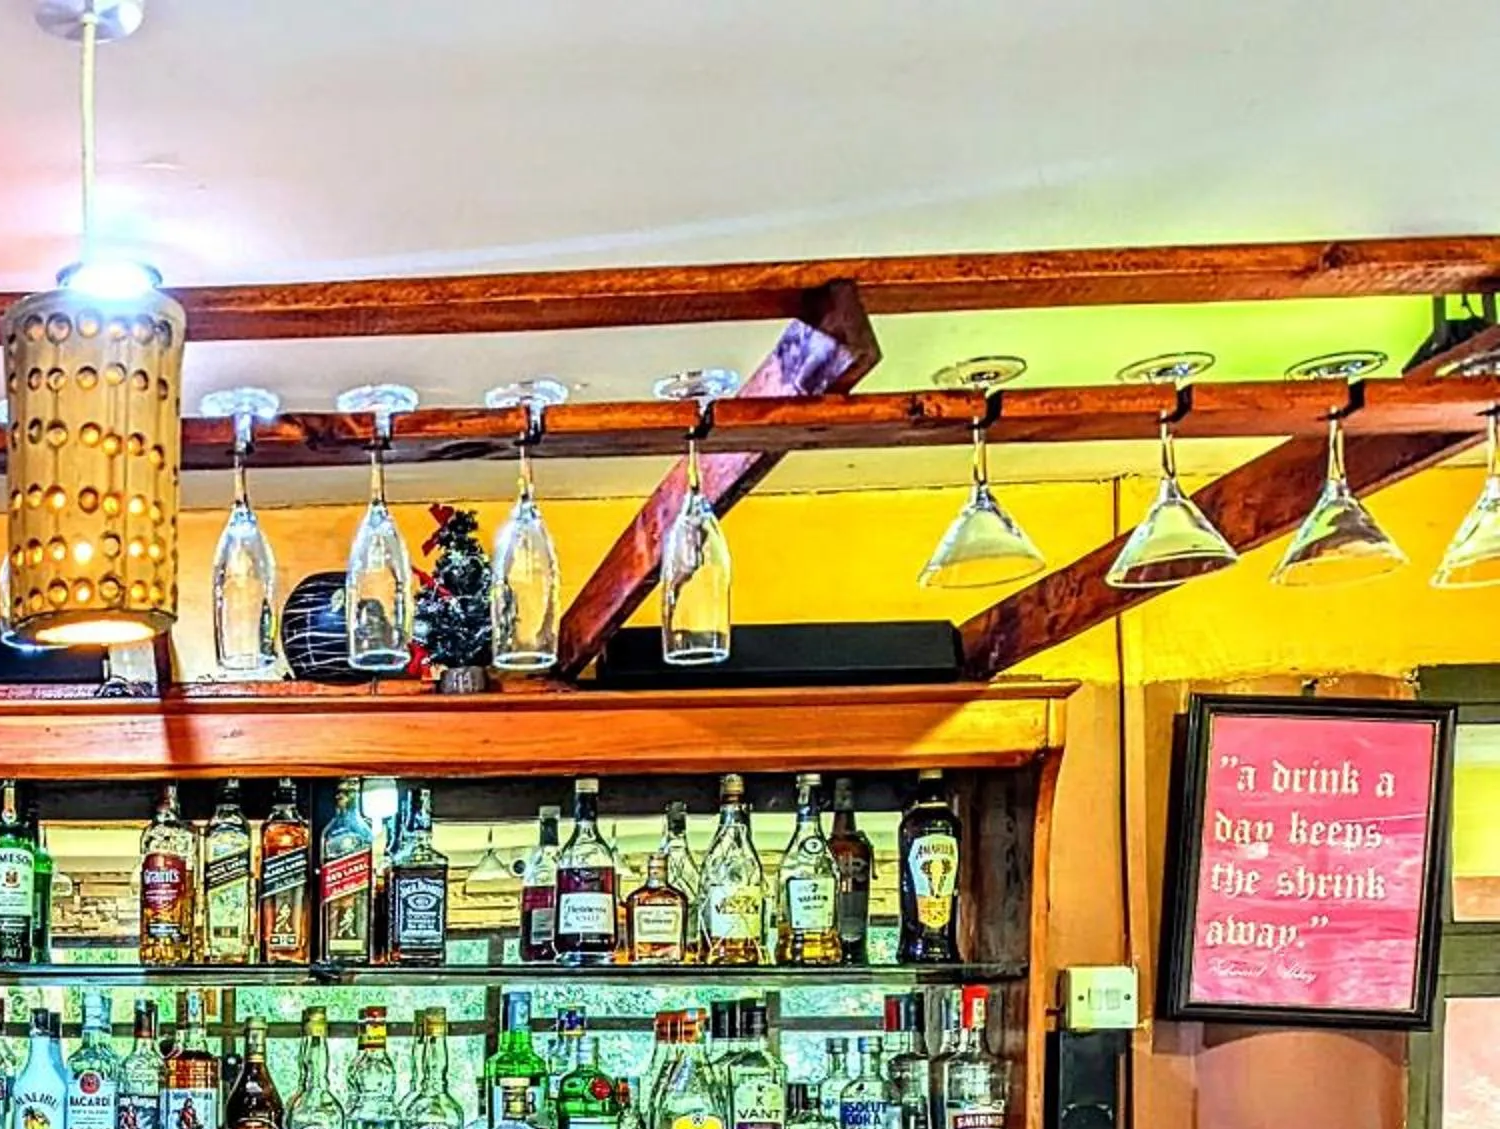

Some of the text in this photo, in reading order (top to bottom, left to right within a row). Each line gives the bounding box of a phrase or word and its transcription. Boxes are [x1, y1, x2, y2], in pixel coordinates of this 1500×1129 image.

[1271, 758, 1361, 796] drink
[1376, 771, 1395, 798] a
[1214, 811, 1383, 852] day keeps
[1210, 862, 1387, 901] the shrink
[737, 1109, 782, 1120] VANT
